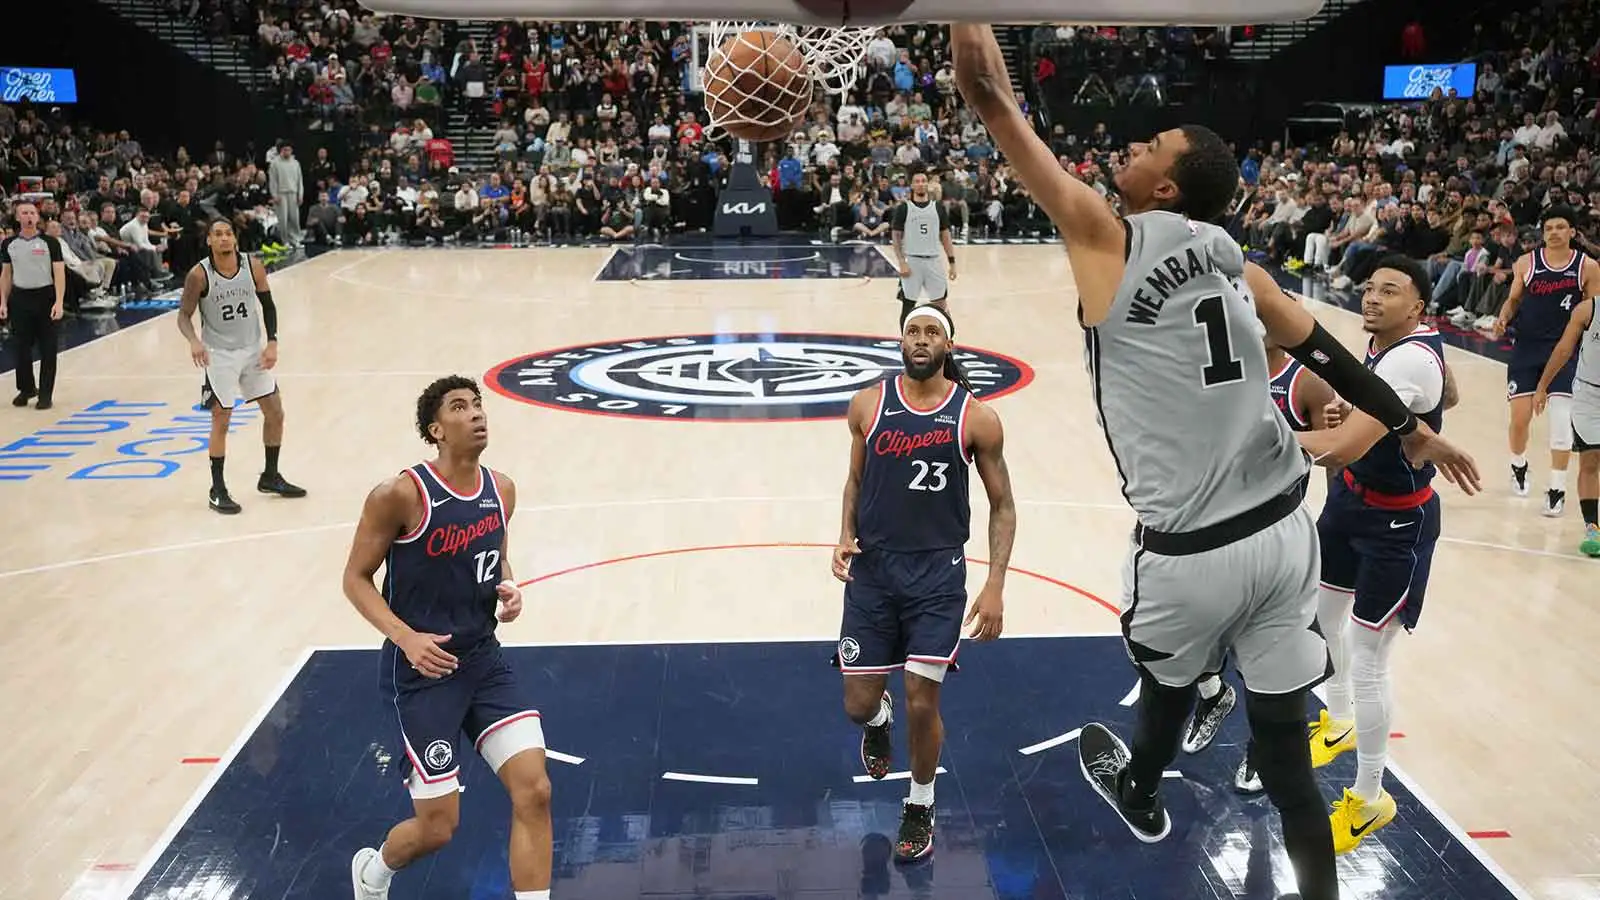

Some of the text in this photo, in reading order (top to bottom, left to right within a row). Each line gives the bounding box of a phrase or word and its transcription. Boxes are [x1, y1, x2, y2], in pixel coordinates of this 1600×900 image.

[723, 202, 766, 214] KIA
[920, 223, 928, 235] 5
[222, 302, 248, 321] 24
[1560, 294, 1573, 310] 4
[1192, 293, 1247, 389] 1
[517, 337, 697, 387] ANGELES
[875, 427, 953, 458] Clippers
[908, 459, 950, 492] 23
[426, 511, 501, 557] Clippers
[474, 549, 500, 584] 12
